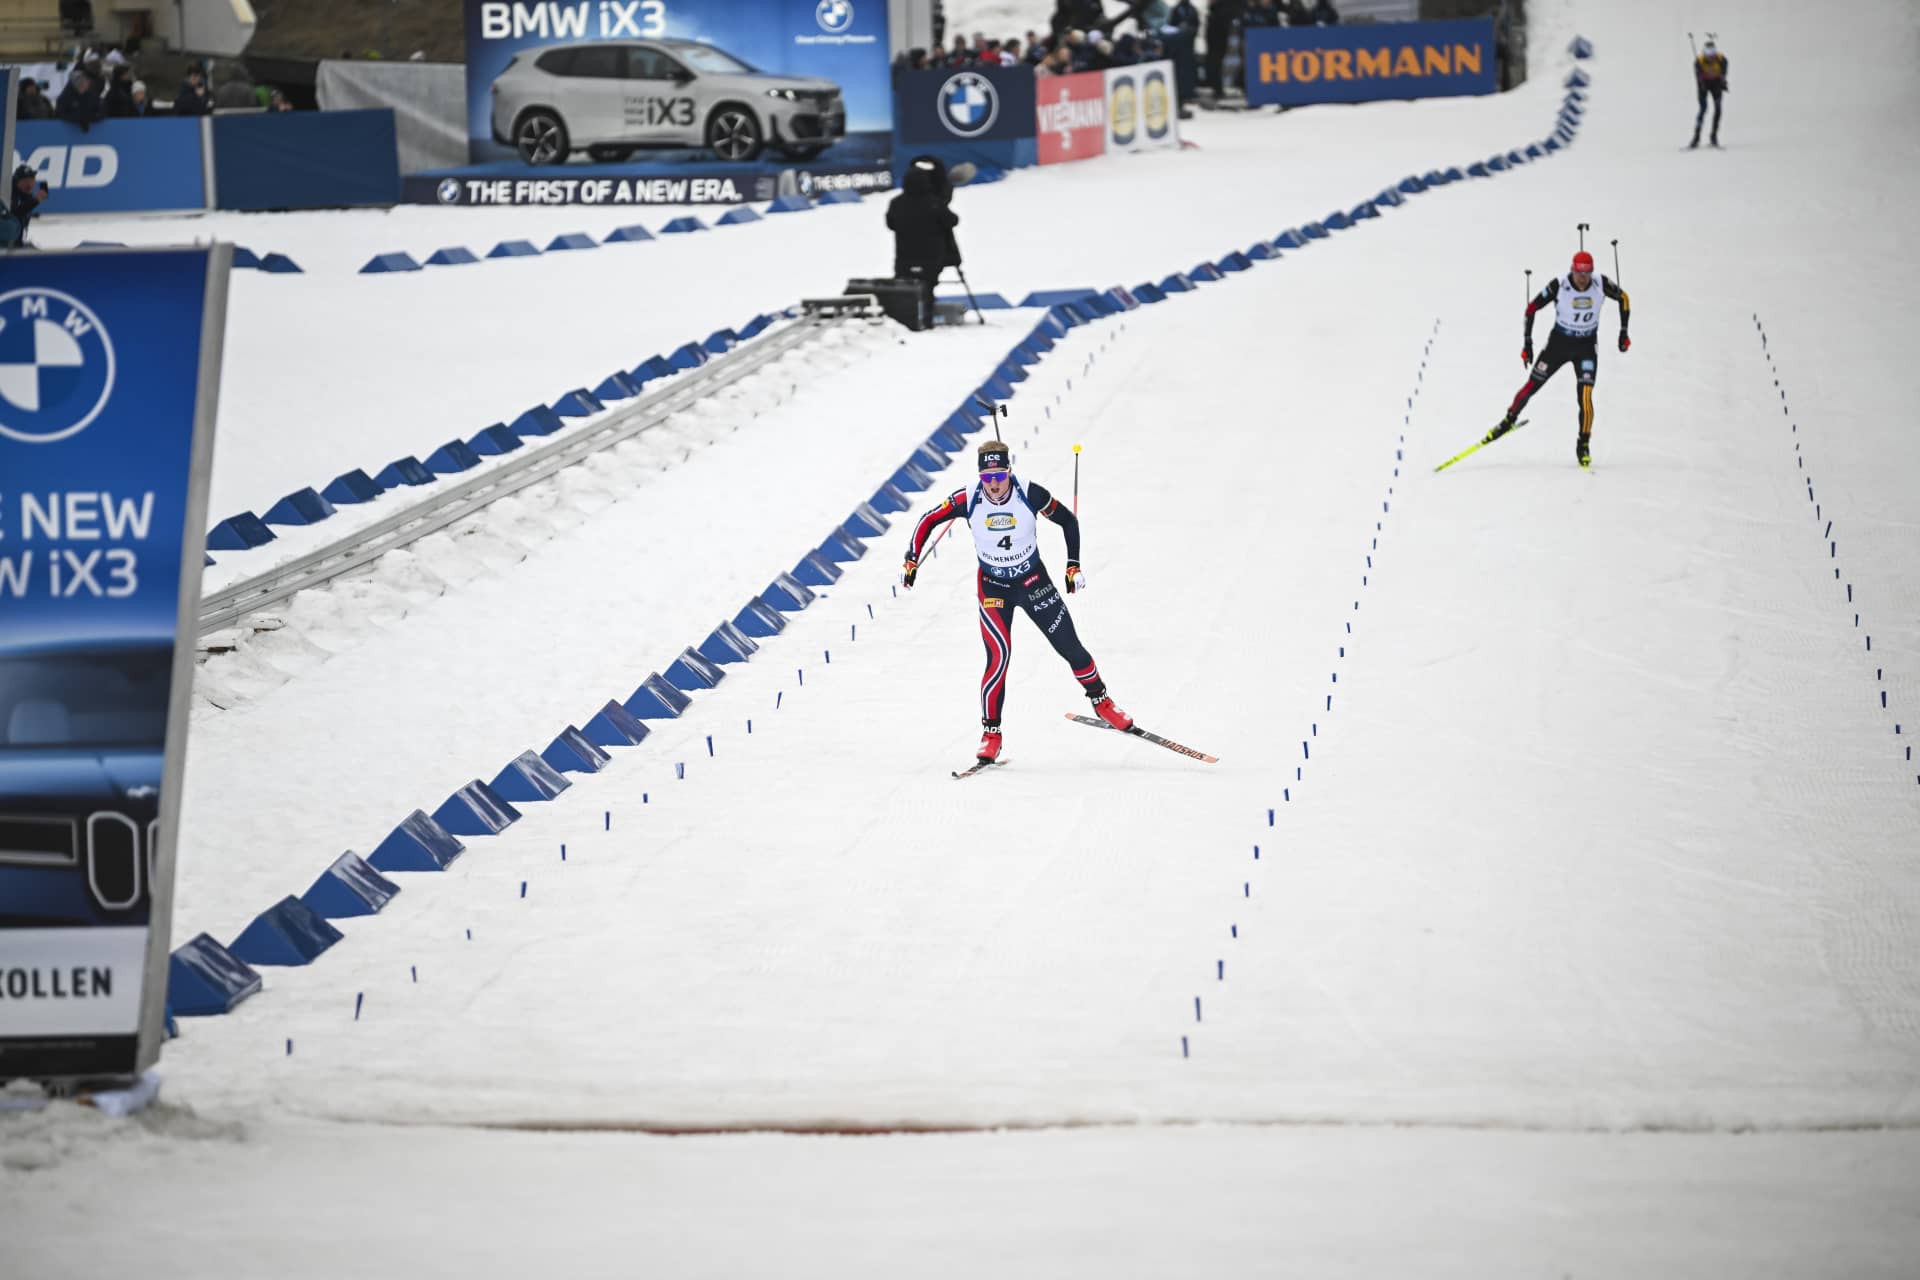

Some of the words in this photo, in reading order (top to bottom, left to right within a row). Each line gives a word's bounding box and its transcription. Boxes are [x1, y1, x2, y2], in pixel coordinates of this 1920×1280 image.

[482, 1, 590, 39] BMW
[600, 0, 666, 38] iX3
[1259, 44, 1481, 84] HÖRMANN
[647, 97, 695, 126] iX3
[12, 145, 118, 189] AD
[466, 180, 512, 203] THE
[515, 180, 579, 203] FIRST
[581, 180, 613, 203] OF
[614, 179, 633, 203] A
[636, 179, 688, 202] NEW
[690, 178, 743, 202] ERA.
[1573, 312, 1594, 323] 10
[984, 454, 1001, 462] ice
[21, 491, 155, 540] NEW
[997, 535, 1013, 551] 4
[49, 549, 139, 598] iX3
[1008, 560, 1031, 578] iX3
[0, 967, 112, 999] OLLEN
